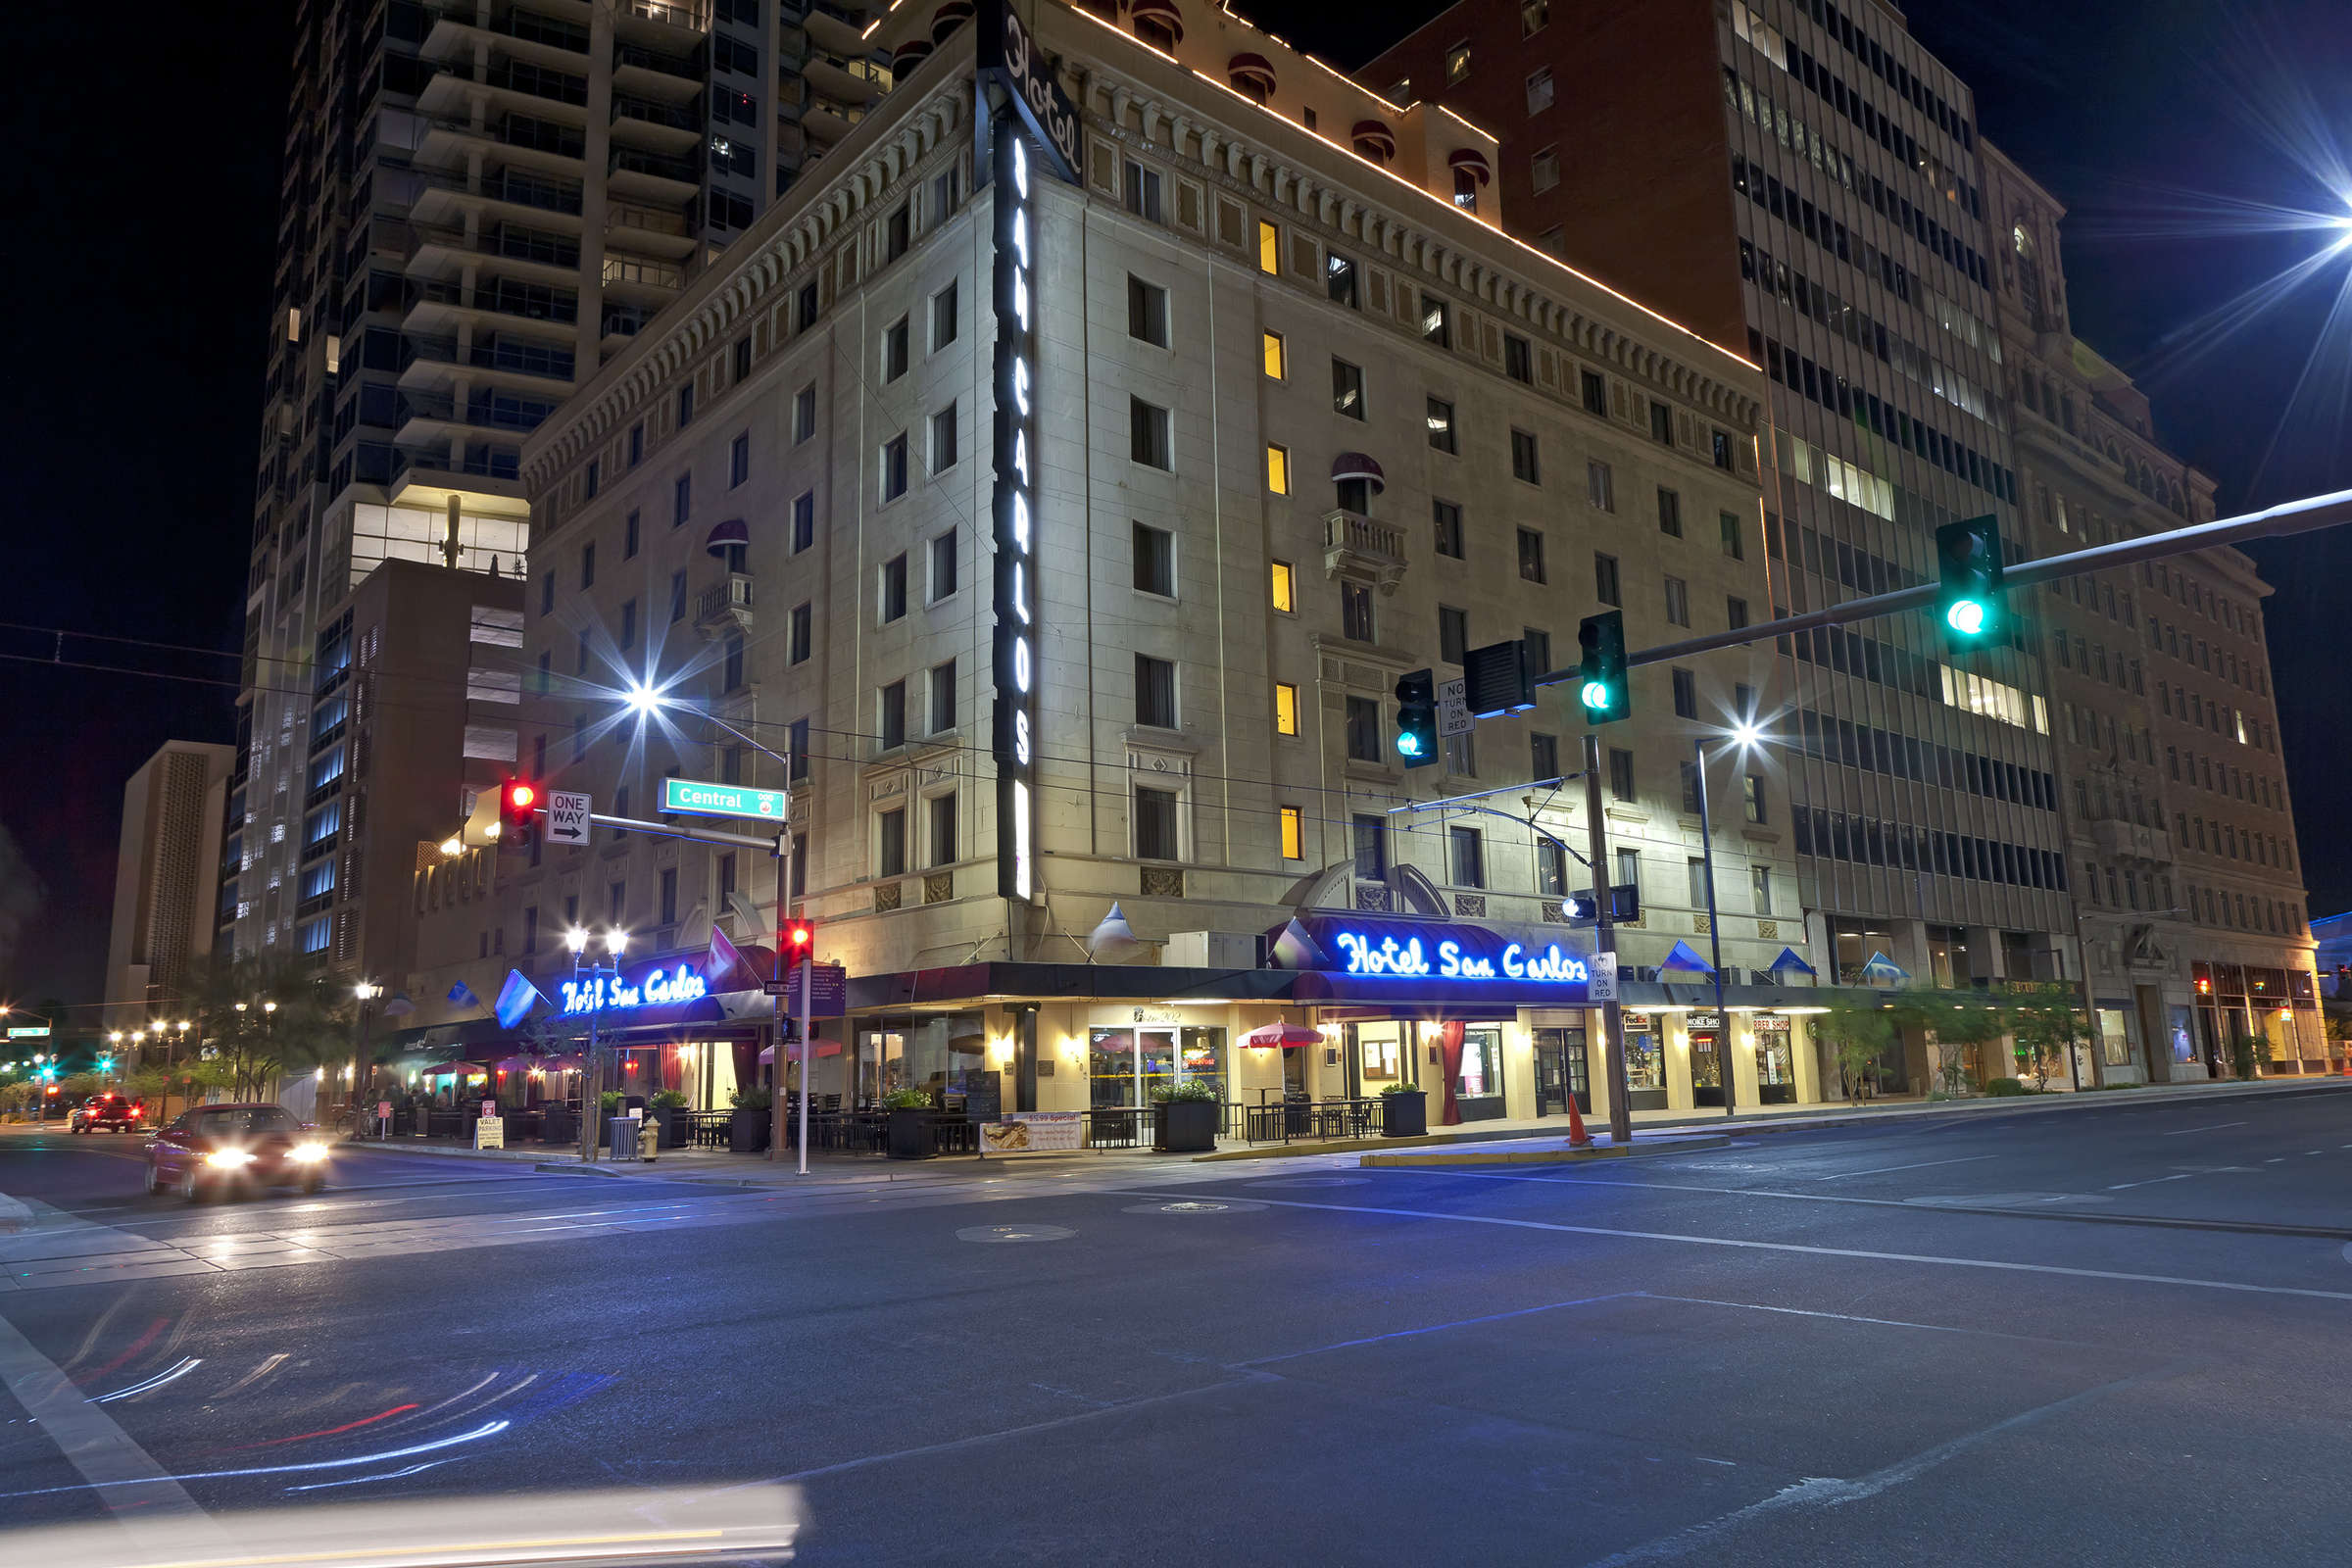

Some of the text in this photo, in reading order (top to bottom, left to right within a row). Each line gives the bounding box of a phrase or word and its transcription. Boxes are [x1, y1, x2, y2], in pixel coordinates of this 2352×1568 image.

[1005, 14, 1081, 174] Hotel
[1014, 137, 1030, 765] SAN CARLOS
[1447, 683, 1464, 697] NO
[1450, 708, 1463, 719] ON
[1448, 719, 1466, 731] RED
[555, 796, 584, 810] ONE
[680, 788, 742, 808] Central
[554, 809, 585, 824] WAY
[1338, 932, 1588, 980] Hotel San Carlos
[1591, 969, 1612, 978] TURN
[644, 963, 706, 1003] Carlos
[1597, 979, 1608, 988] ON
[1594, 989, 1611, 998] RED
[1625, 1015, 1647, 1024] FedEx
[1706, 1017, 1720, 1027] SHO
[1753, 1020, 1788, 1030] RBER SHOP
[1050, 1113, 1076, 1122] Special
